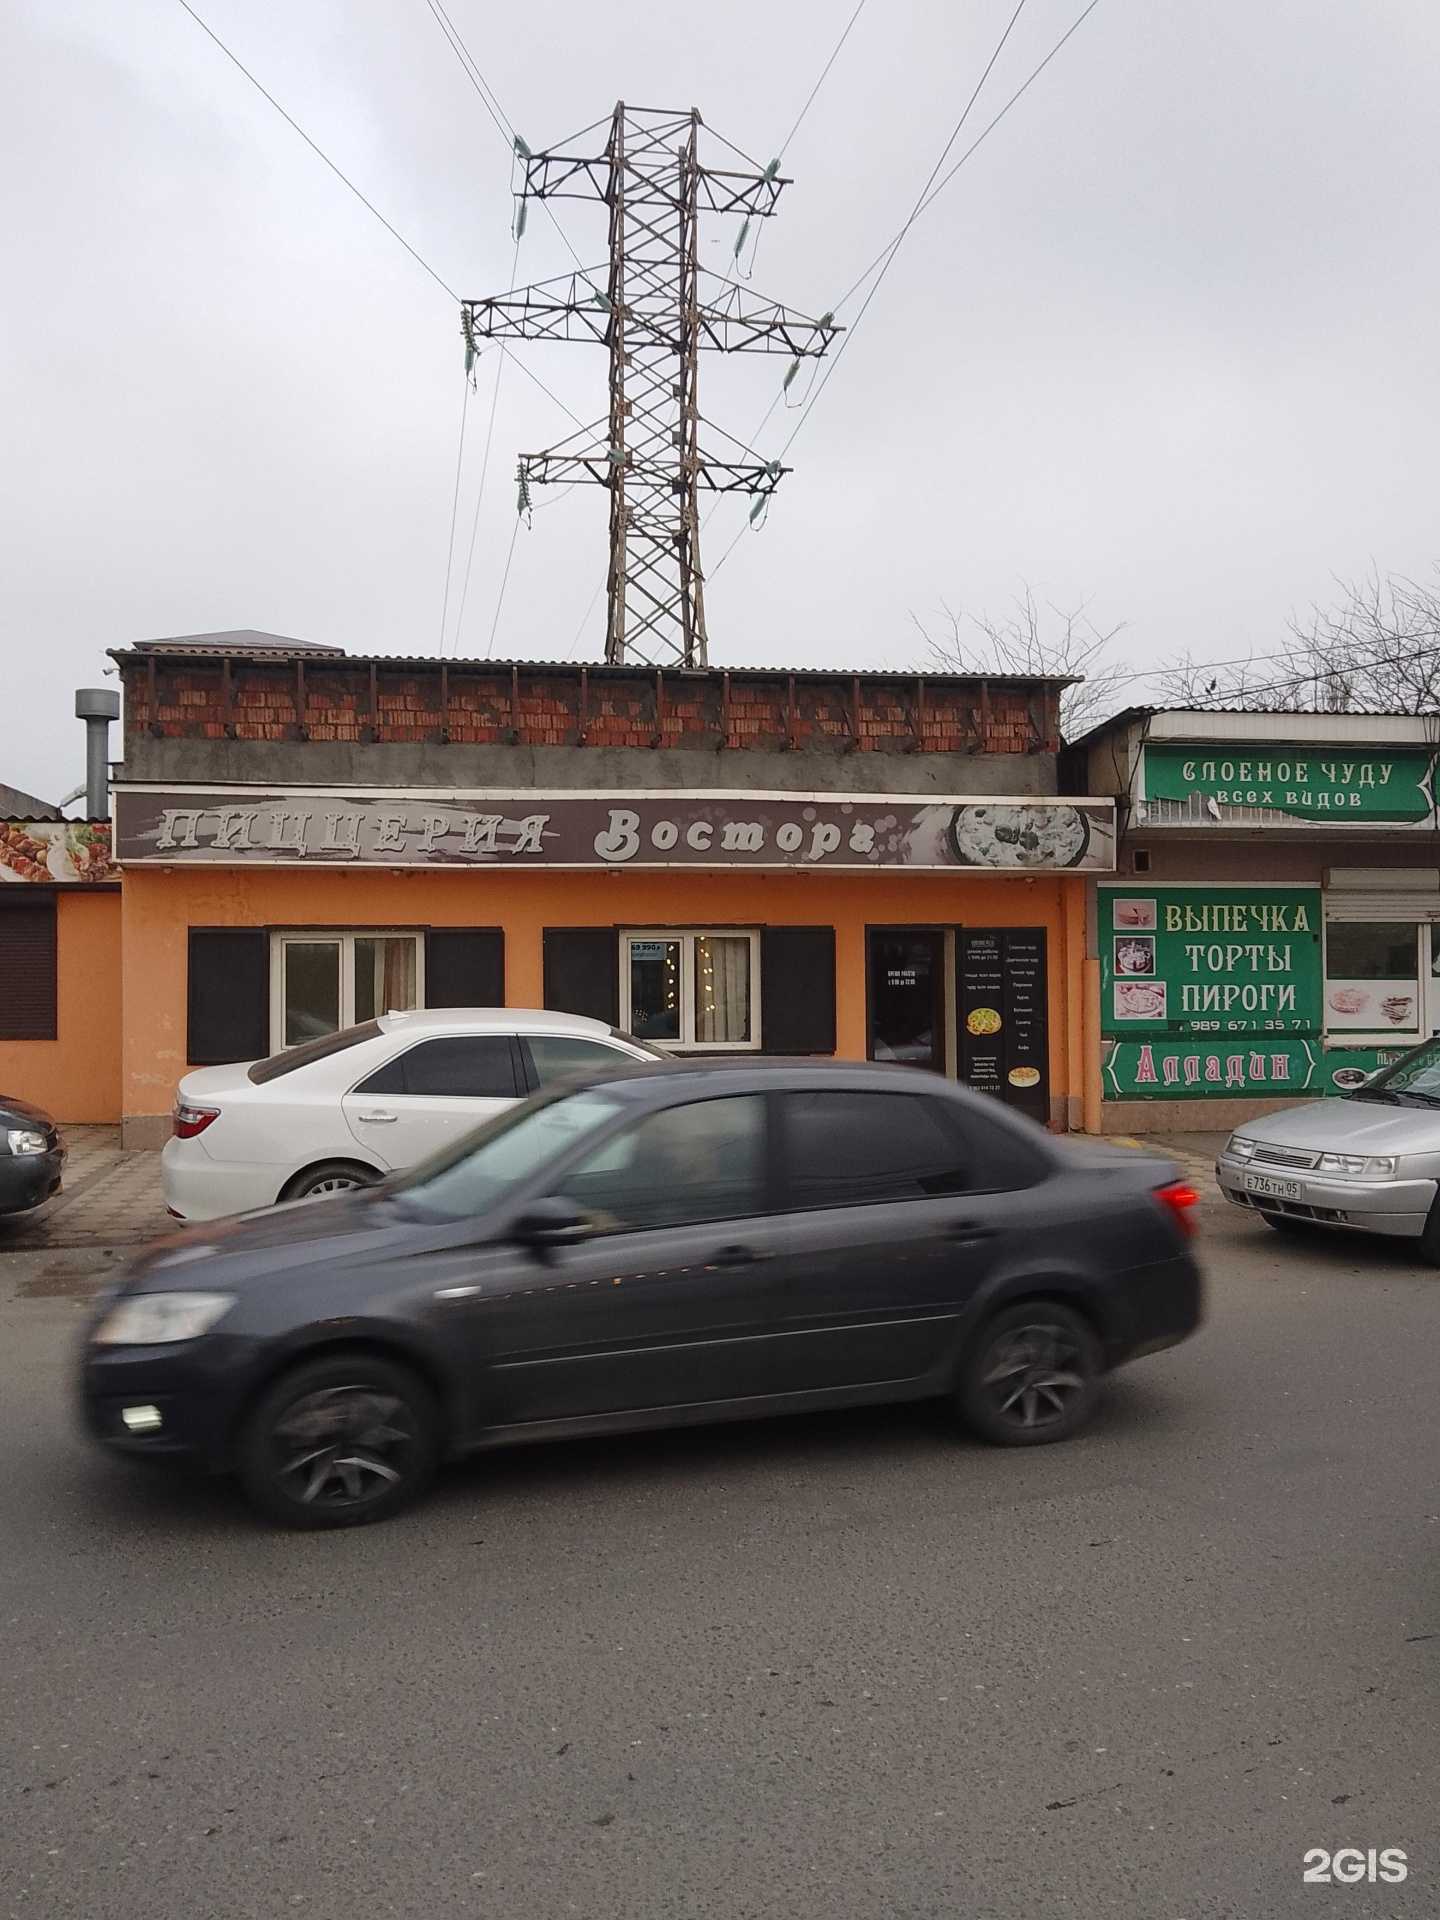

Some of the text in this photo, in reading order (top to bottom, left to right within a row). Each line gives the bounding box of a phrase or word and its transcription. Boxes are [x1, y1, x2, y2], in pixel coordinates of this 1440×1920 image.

[1182, 761, 1394, 789] СЛОЕНОЕ ЧУДУ
[155, 808, 876, 863] ПИЦЦЕРИЯ Восторг
[1165, 904, 1311, 933] ВЫПЕЧКА
[1184, 944, 1292, 972] ТОРТЫ
[1181, 983, 1297, 1013] ПИРОГИ
[1264, 1020, 1285, 1030] 35
[1134, 1044, 1291, 1088] Алладин
